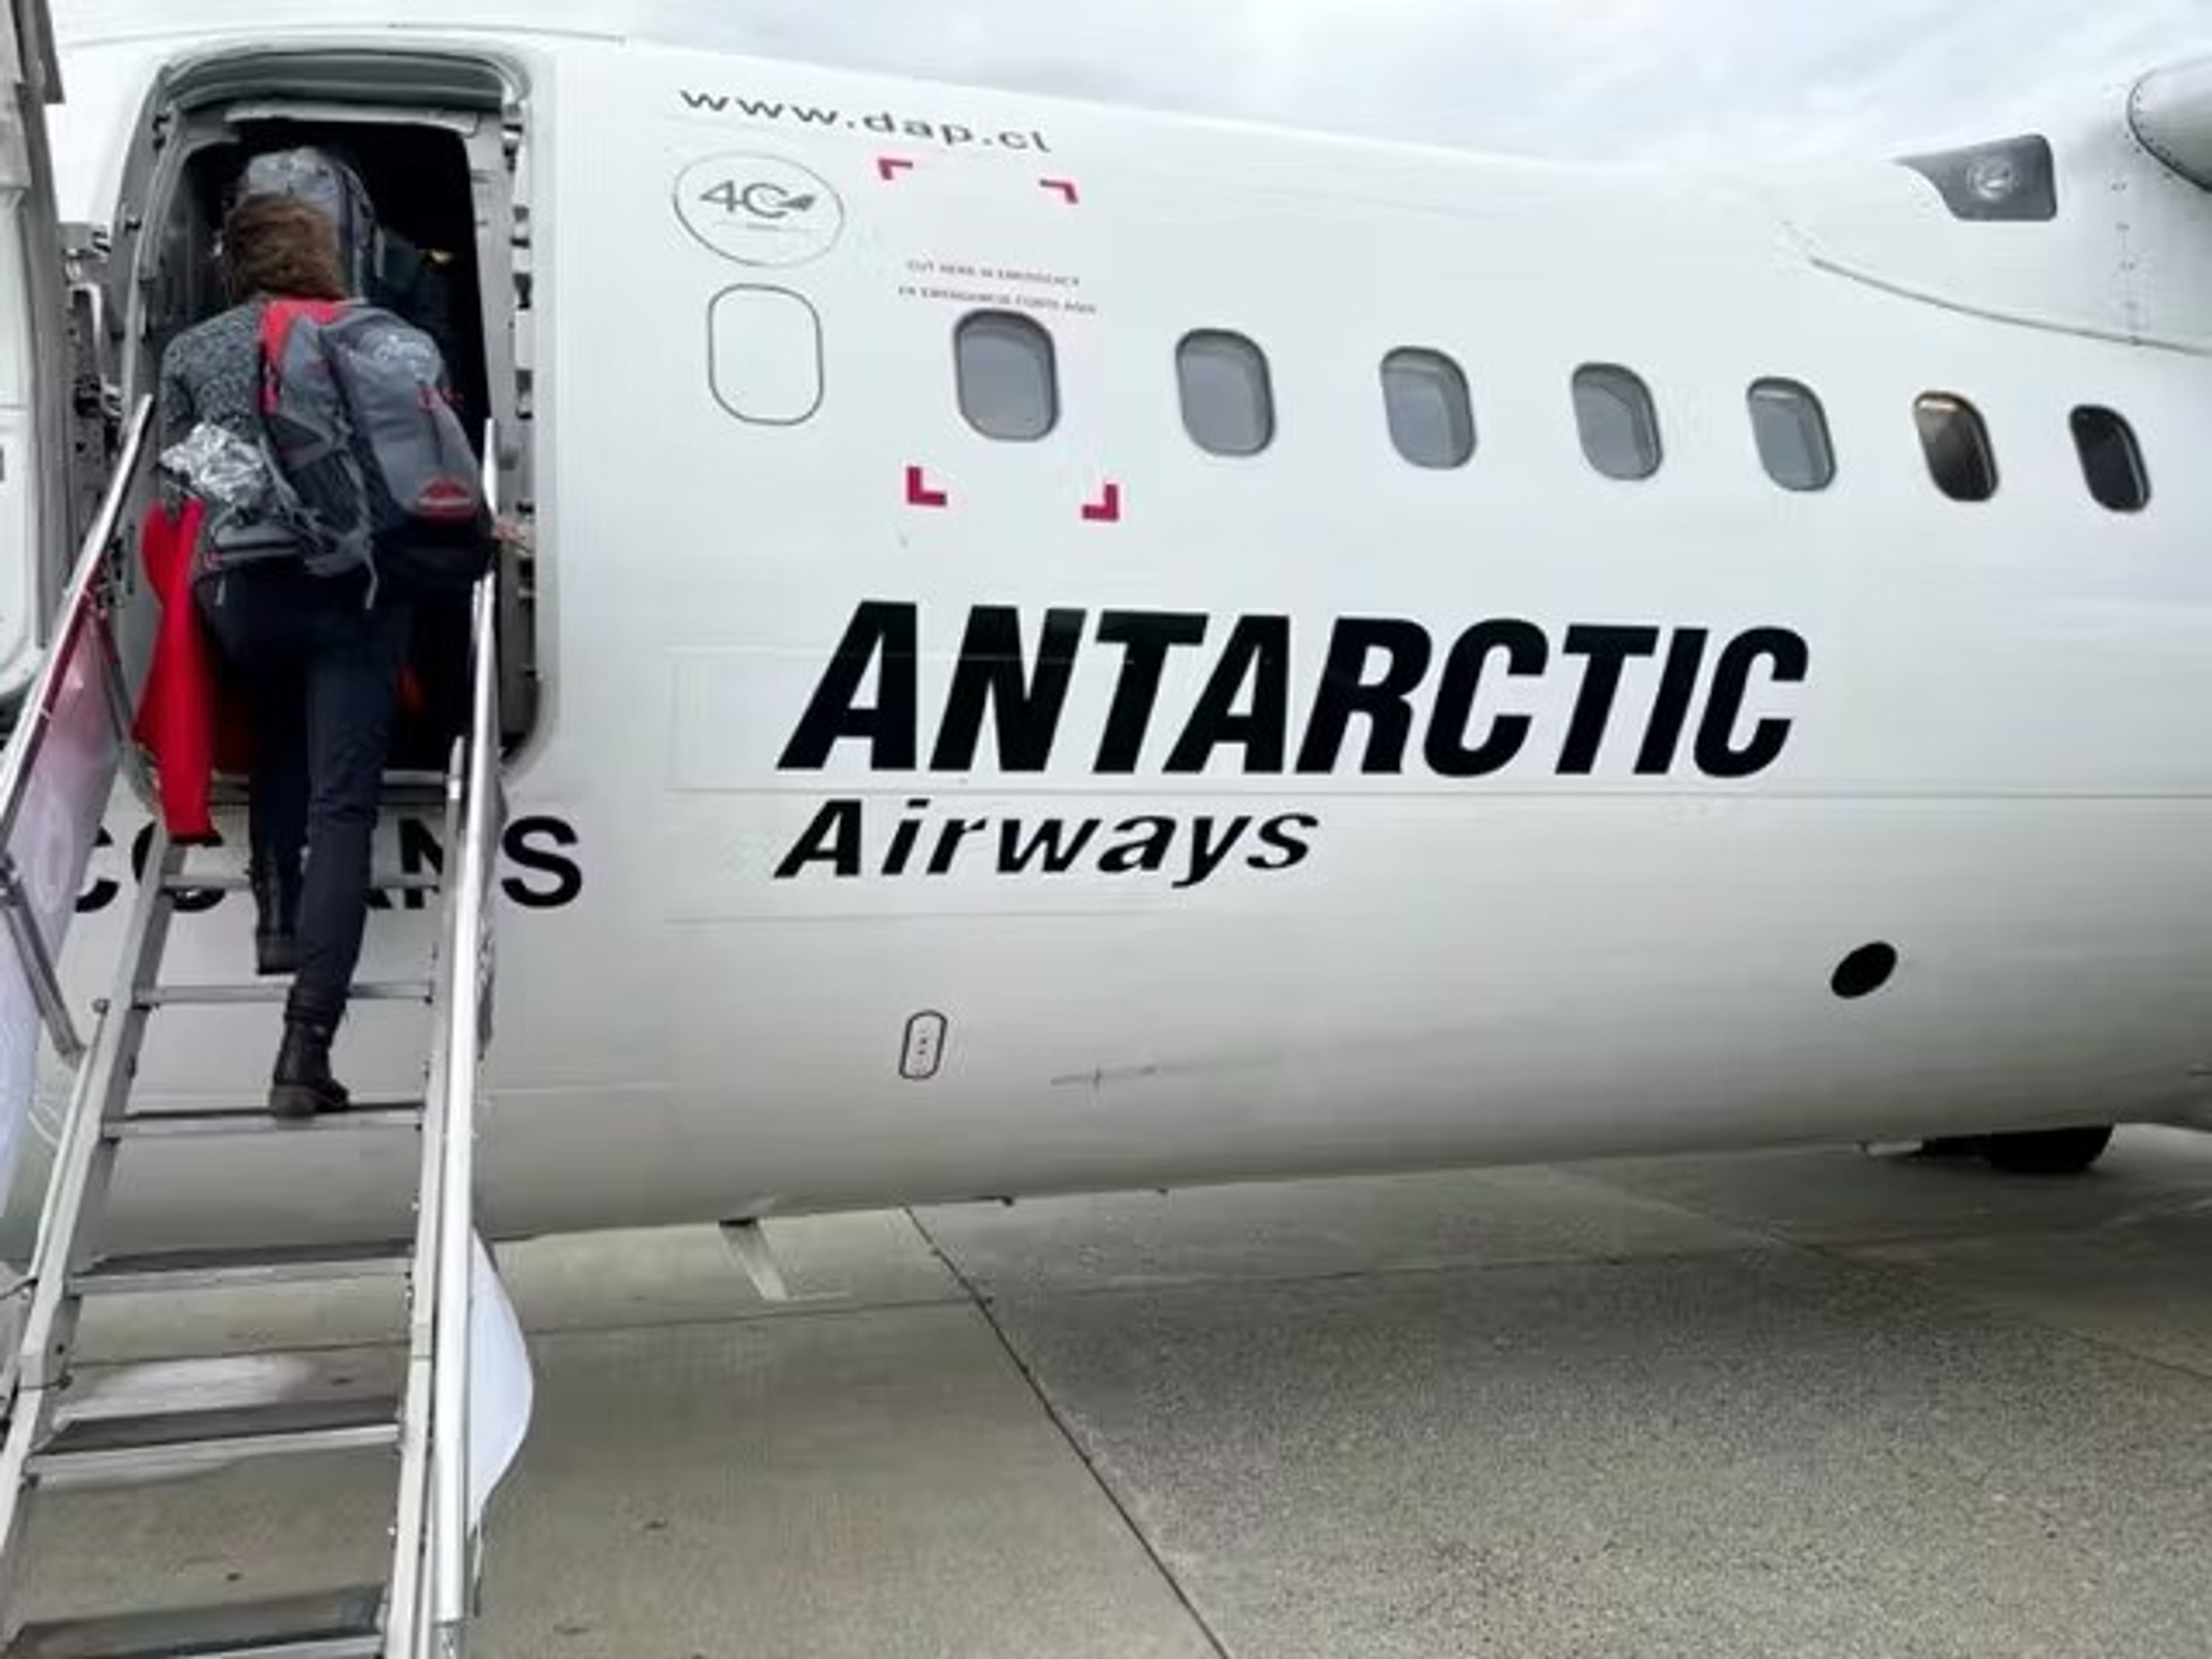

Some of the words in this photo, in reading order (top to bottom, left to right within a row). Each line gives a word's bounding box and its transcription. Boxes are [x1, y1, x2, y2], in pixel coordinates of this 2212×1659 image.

[680, 89, 1052, 153] www.dap.cl
[777, 601, 1808, 778] ANTARCTIC
[774, 799, 1319, 888] Airways
